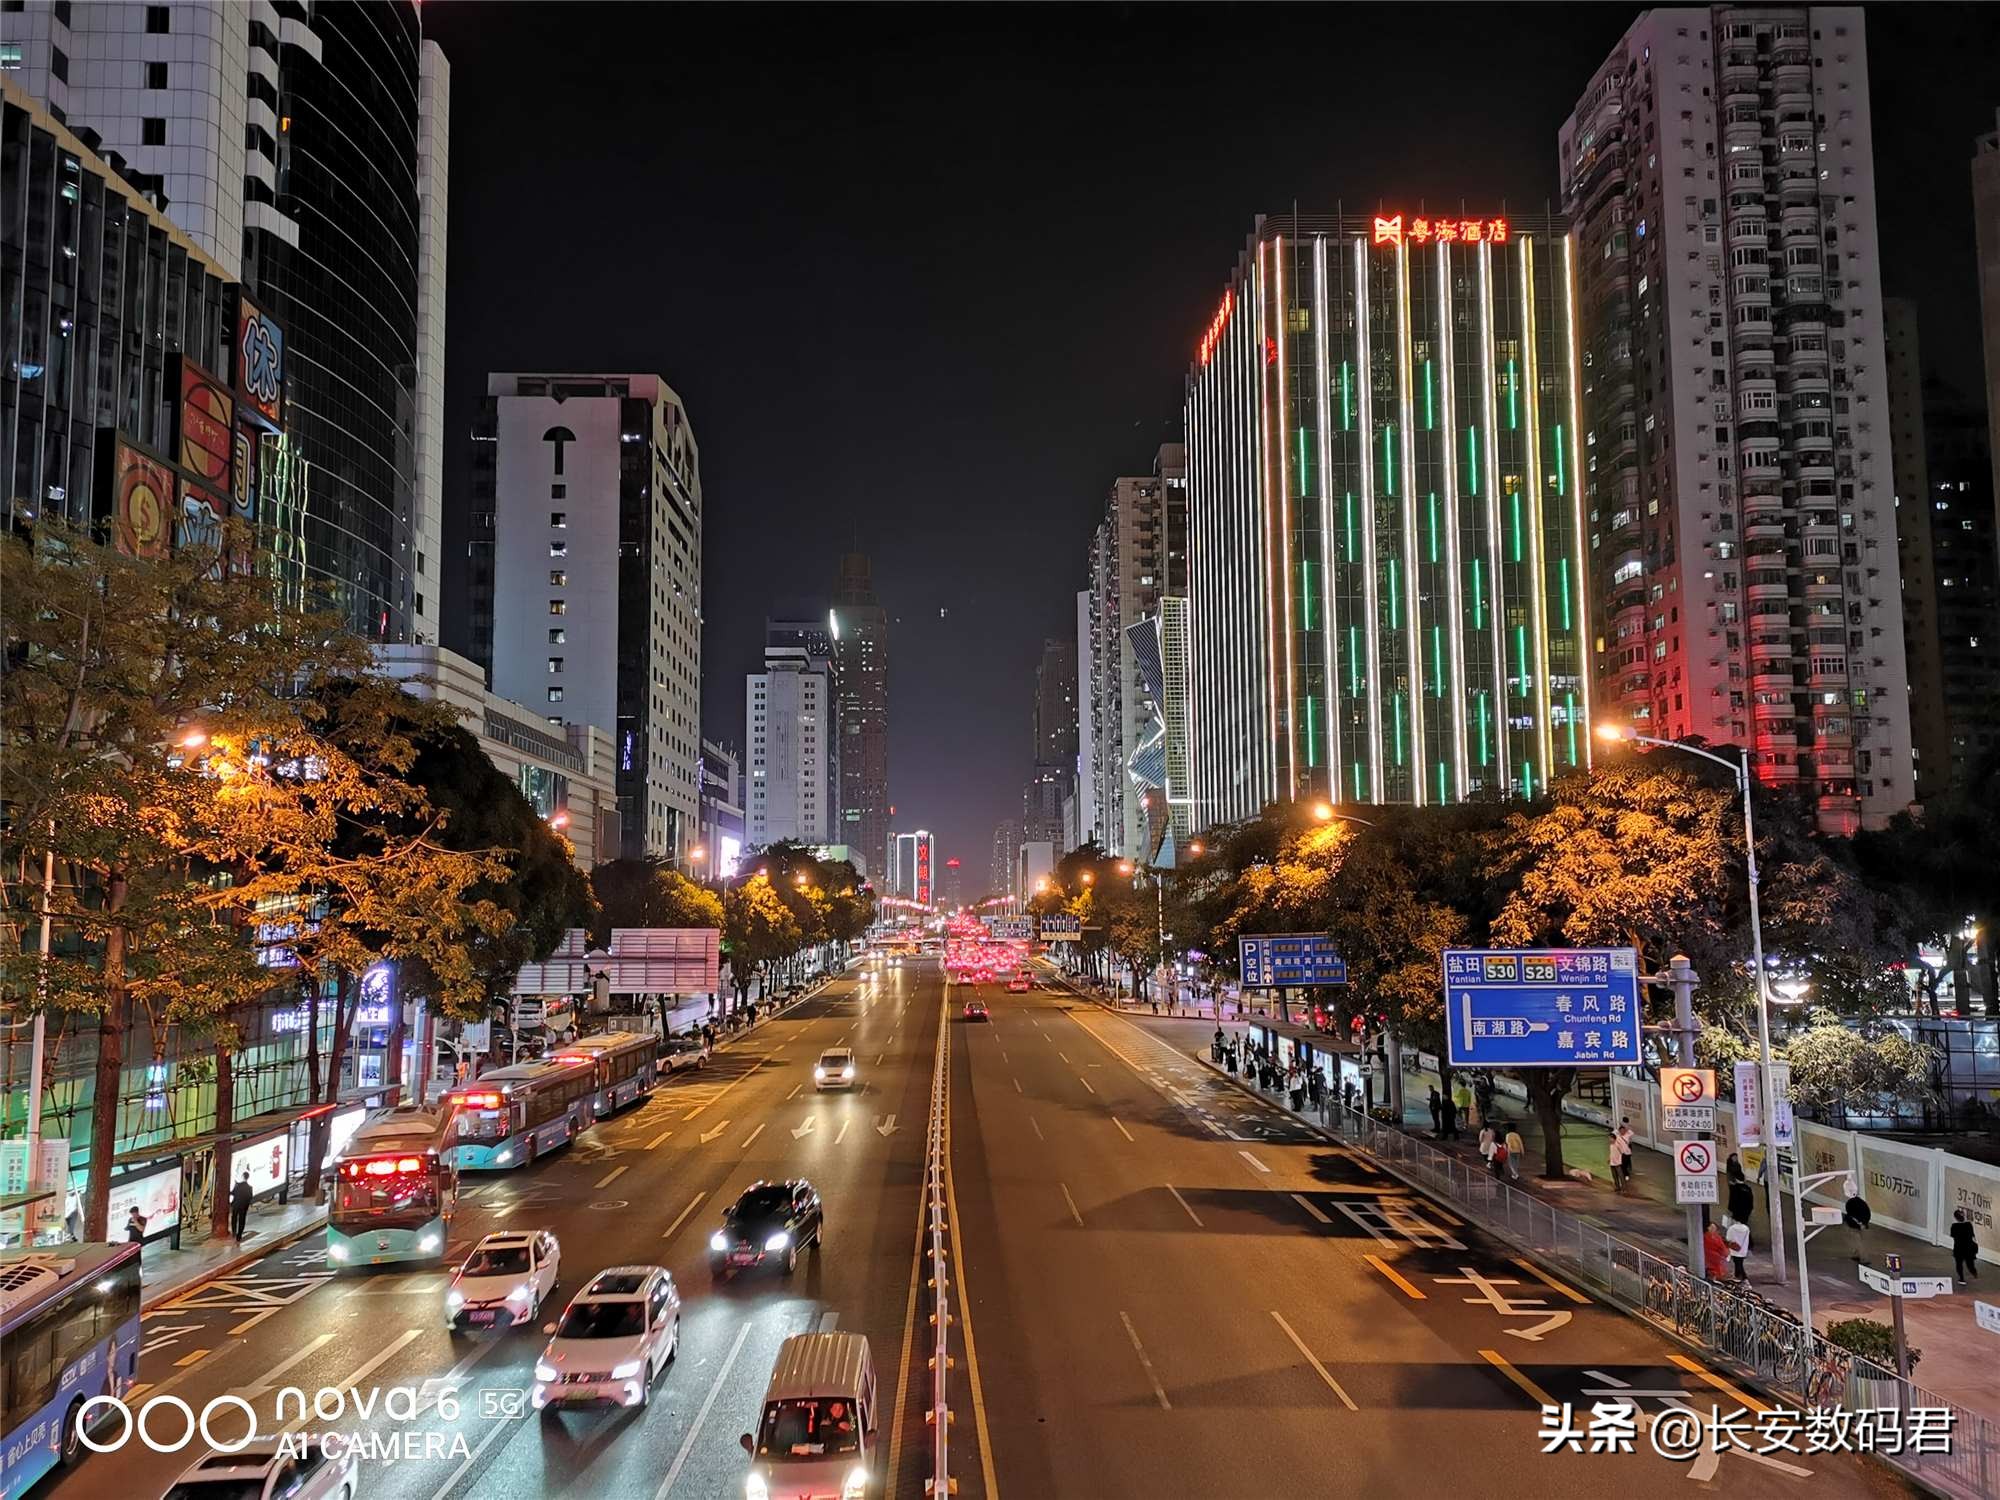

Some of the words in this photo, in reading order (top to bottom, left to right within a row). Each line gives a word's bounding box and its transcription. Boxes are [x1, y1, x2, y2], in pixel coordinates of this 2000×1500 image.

[1408, 217, 1508, 244] 粤海酒店
[242, 315, 279, 403] 休
[1448, 956, 1481, 974] 盐田
[1486, 965, 1516, 979] S30
[1559, 956, 1608, 973] 文锦路
[1449, 974, 1482, 984] Yantian
[1525, 966, 1554, 980] S28
[1561, 974, 1590, 984] Wenjin
[1595, 974, 1607, 983] Rd
[1555, 995, 1627, 1013] 春风路
[1564, 1014, 1607, 1025] Chunfeng
[1608, 1014, 1622, 1023] Rd
[1472, 1020, 1525, 1036] 南湖路
[1557, 1031, 1629, 1049] 嘉宾路
[1574, 1051, 1599, 1060] Jiabin
[1603, 1051, 1615, 1060] Rd
